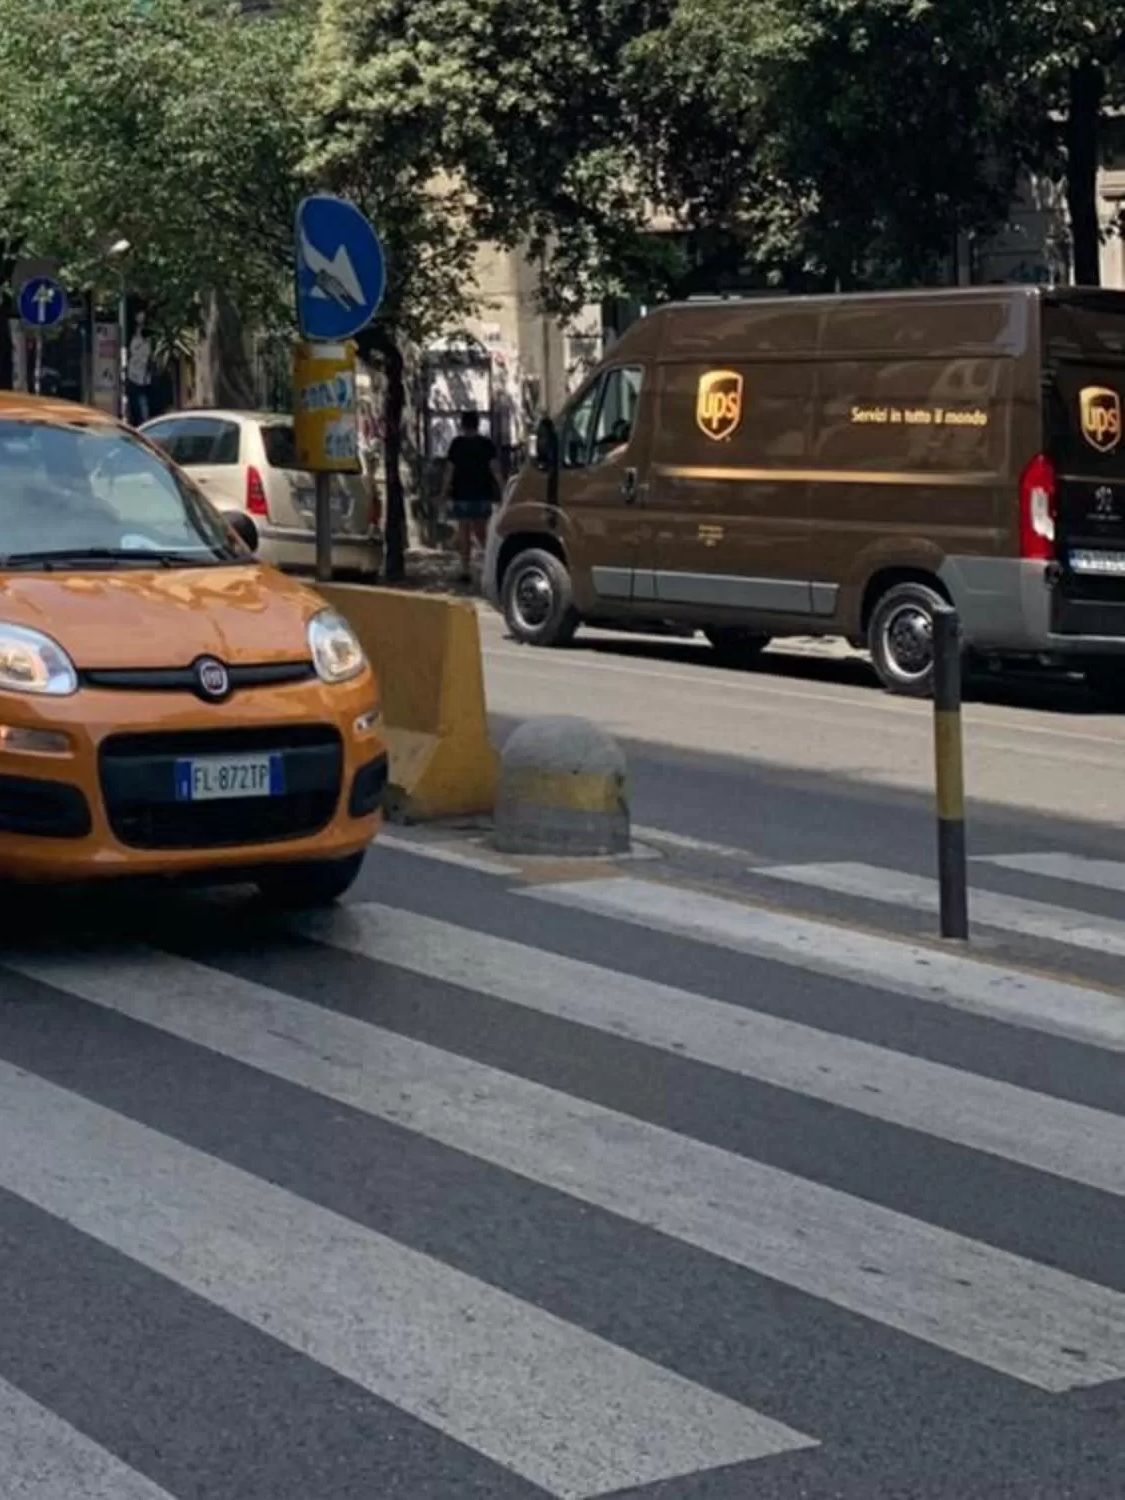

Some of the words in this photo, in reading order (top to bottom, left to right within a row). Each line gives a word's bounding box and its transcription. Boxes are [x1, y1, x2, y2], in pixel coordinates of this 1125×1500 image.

[851, 406, 888, 423] Servizi
[890, 407, 902, 423] in
[904, 407, 931, 424] tutto
[945, 409, 987, 425] mondo
